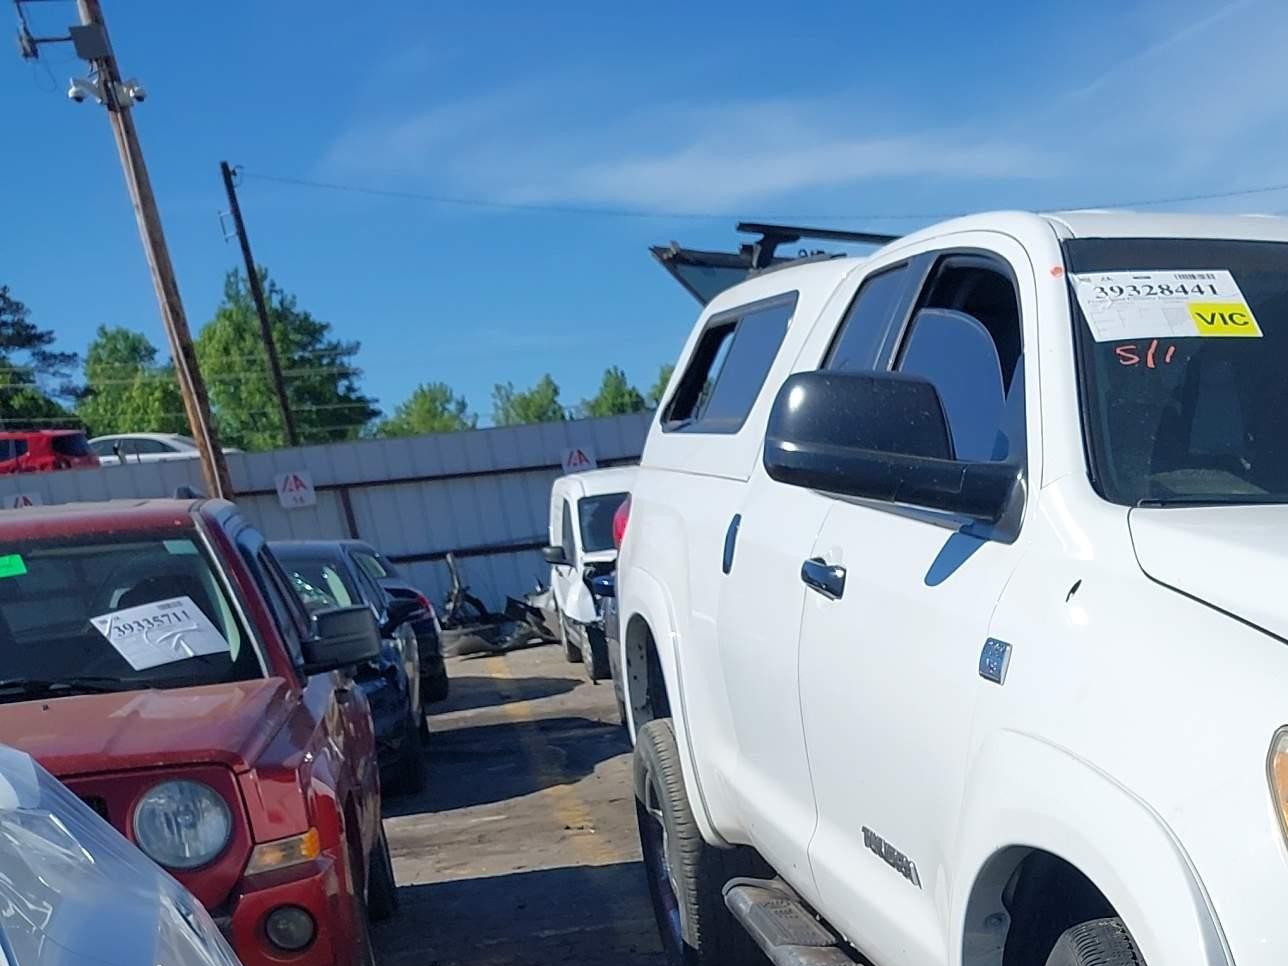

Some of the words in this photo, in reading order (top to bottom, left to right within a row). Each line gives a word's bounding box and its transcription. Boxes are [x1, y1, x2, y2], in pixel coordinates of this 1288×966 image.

[1094, 282, 1219, 299] 39328441
[1195, 311, 1250, 327] VIC
[112, 609, 192, 638] 39335711
